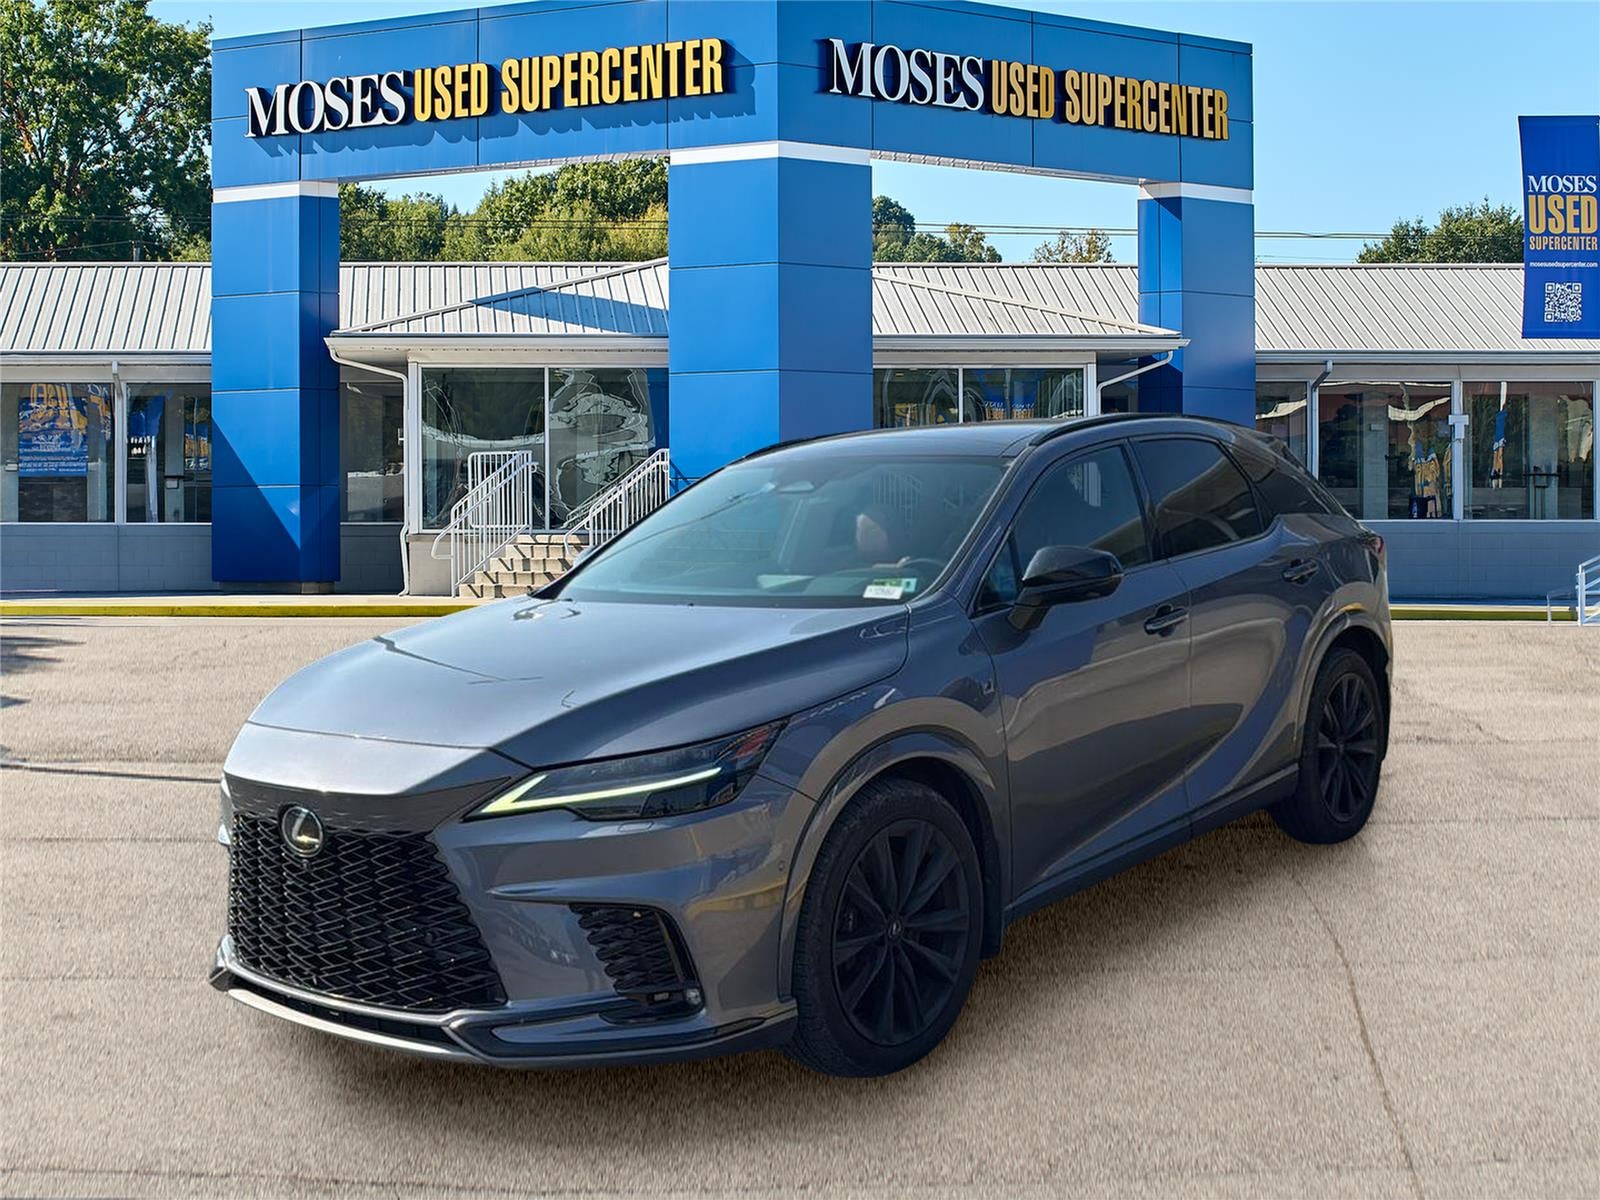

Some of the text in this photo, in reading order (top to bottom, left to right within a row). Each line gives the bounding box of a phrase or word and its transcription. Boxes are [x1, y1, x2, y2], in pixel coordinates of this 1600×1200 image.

[244, 38, 723, 138] MOSES USED SUPERCENTER
[829, 38, 1229, 140] MOSES USED SUPERCENTER
[1528, 175, 1597, 193] MOSES
[1528, 194, 1598, 234] USED
[1529, 236, 1598, 250] SUPERCENTER
